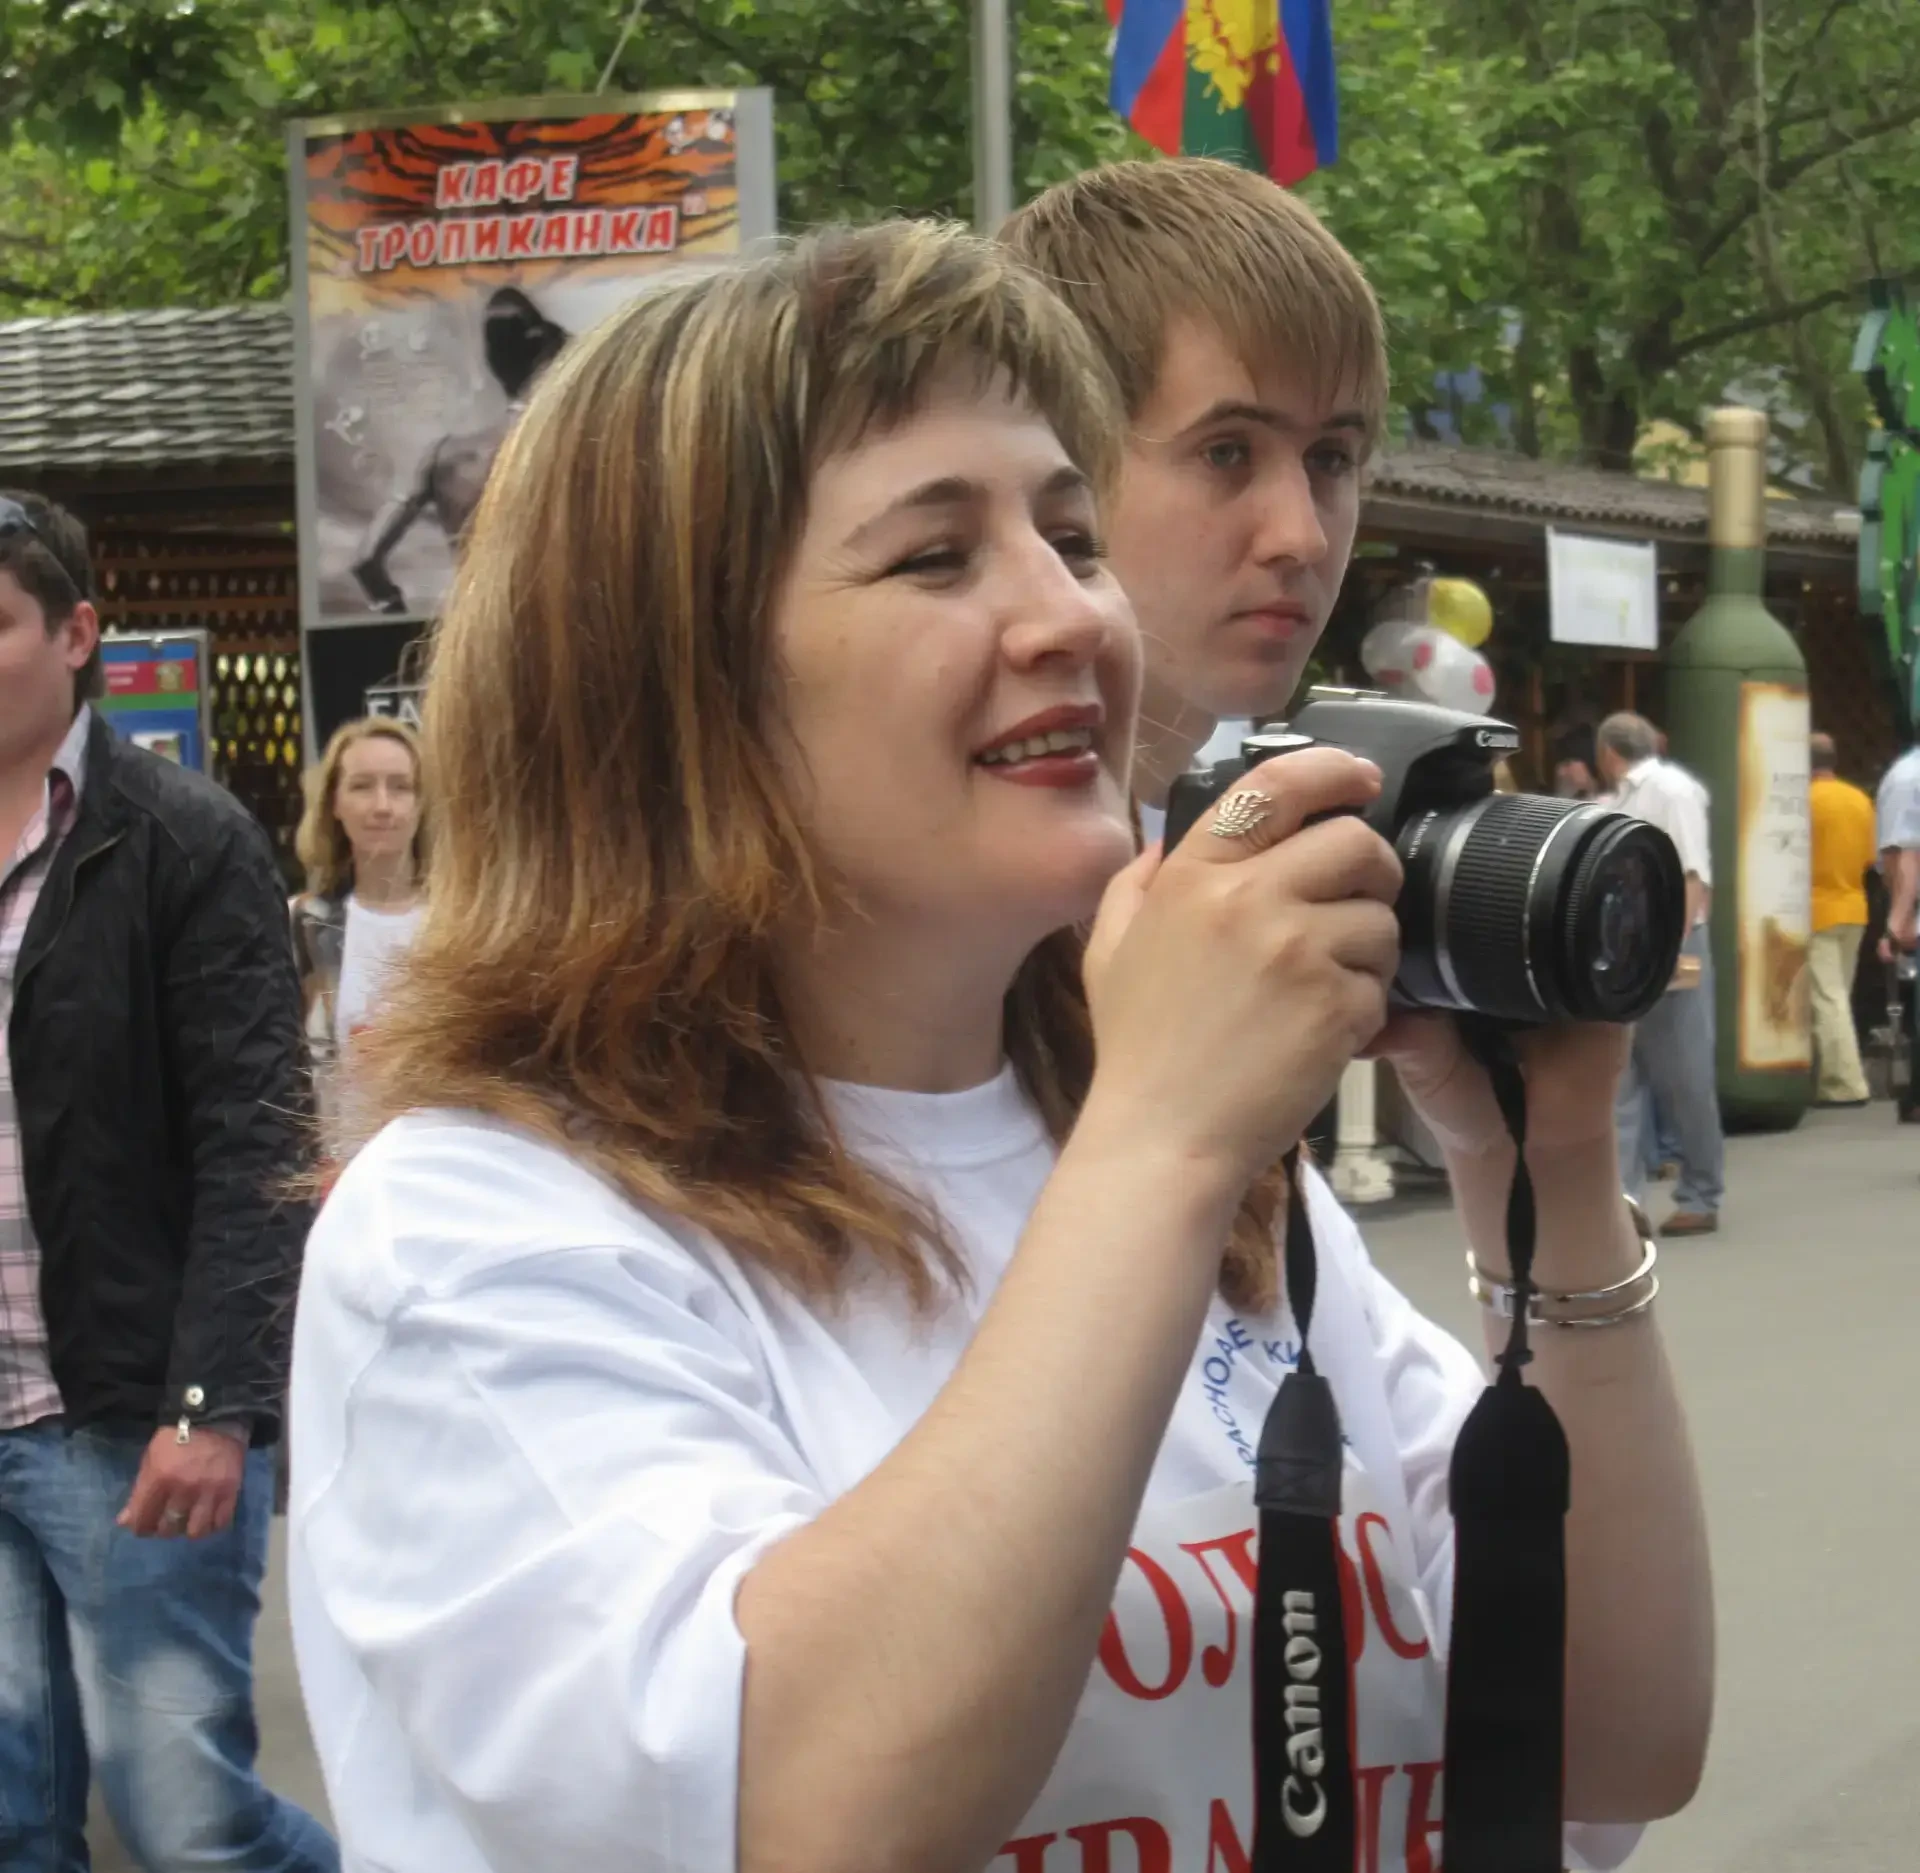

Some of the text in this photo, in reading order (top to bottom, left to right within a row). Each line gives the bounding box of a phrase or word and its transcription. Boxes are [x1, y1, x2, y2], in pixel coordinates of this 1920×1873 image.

[437, 156, 577, 208] КАФЕ
[356, 205, 678, 272] ТРОПИКАНКА
[1281, 1590, 1328, 1838] Canon
